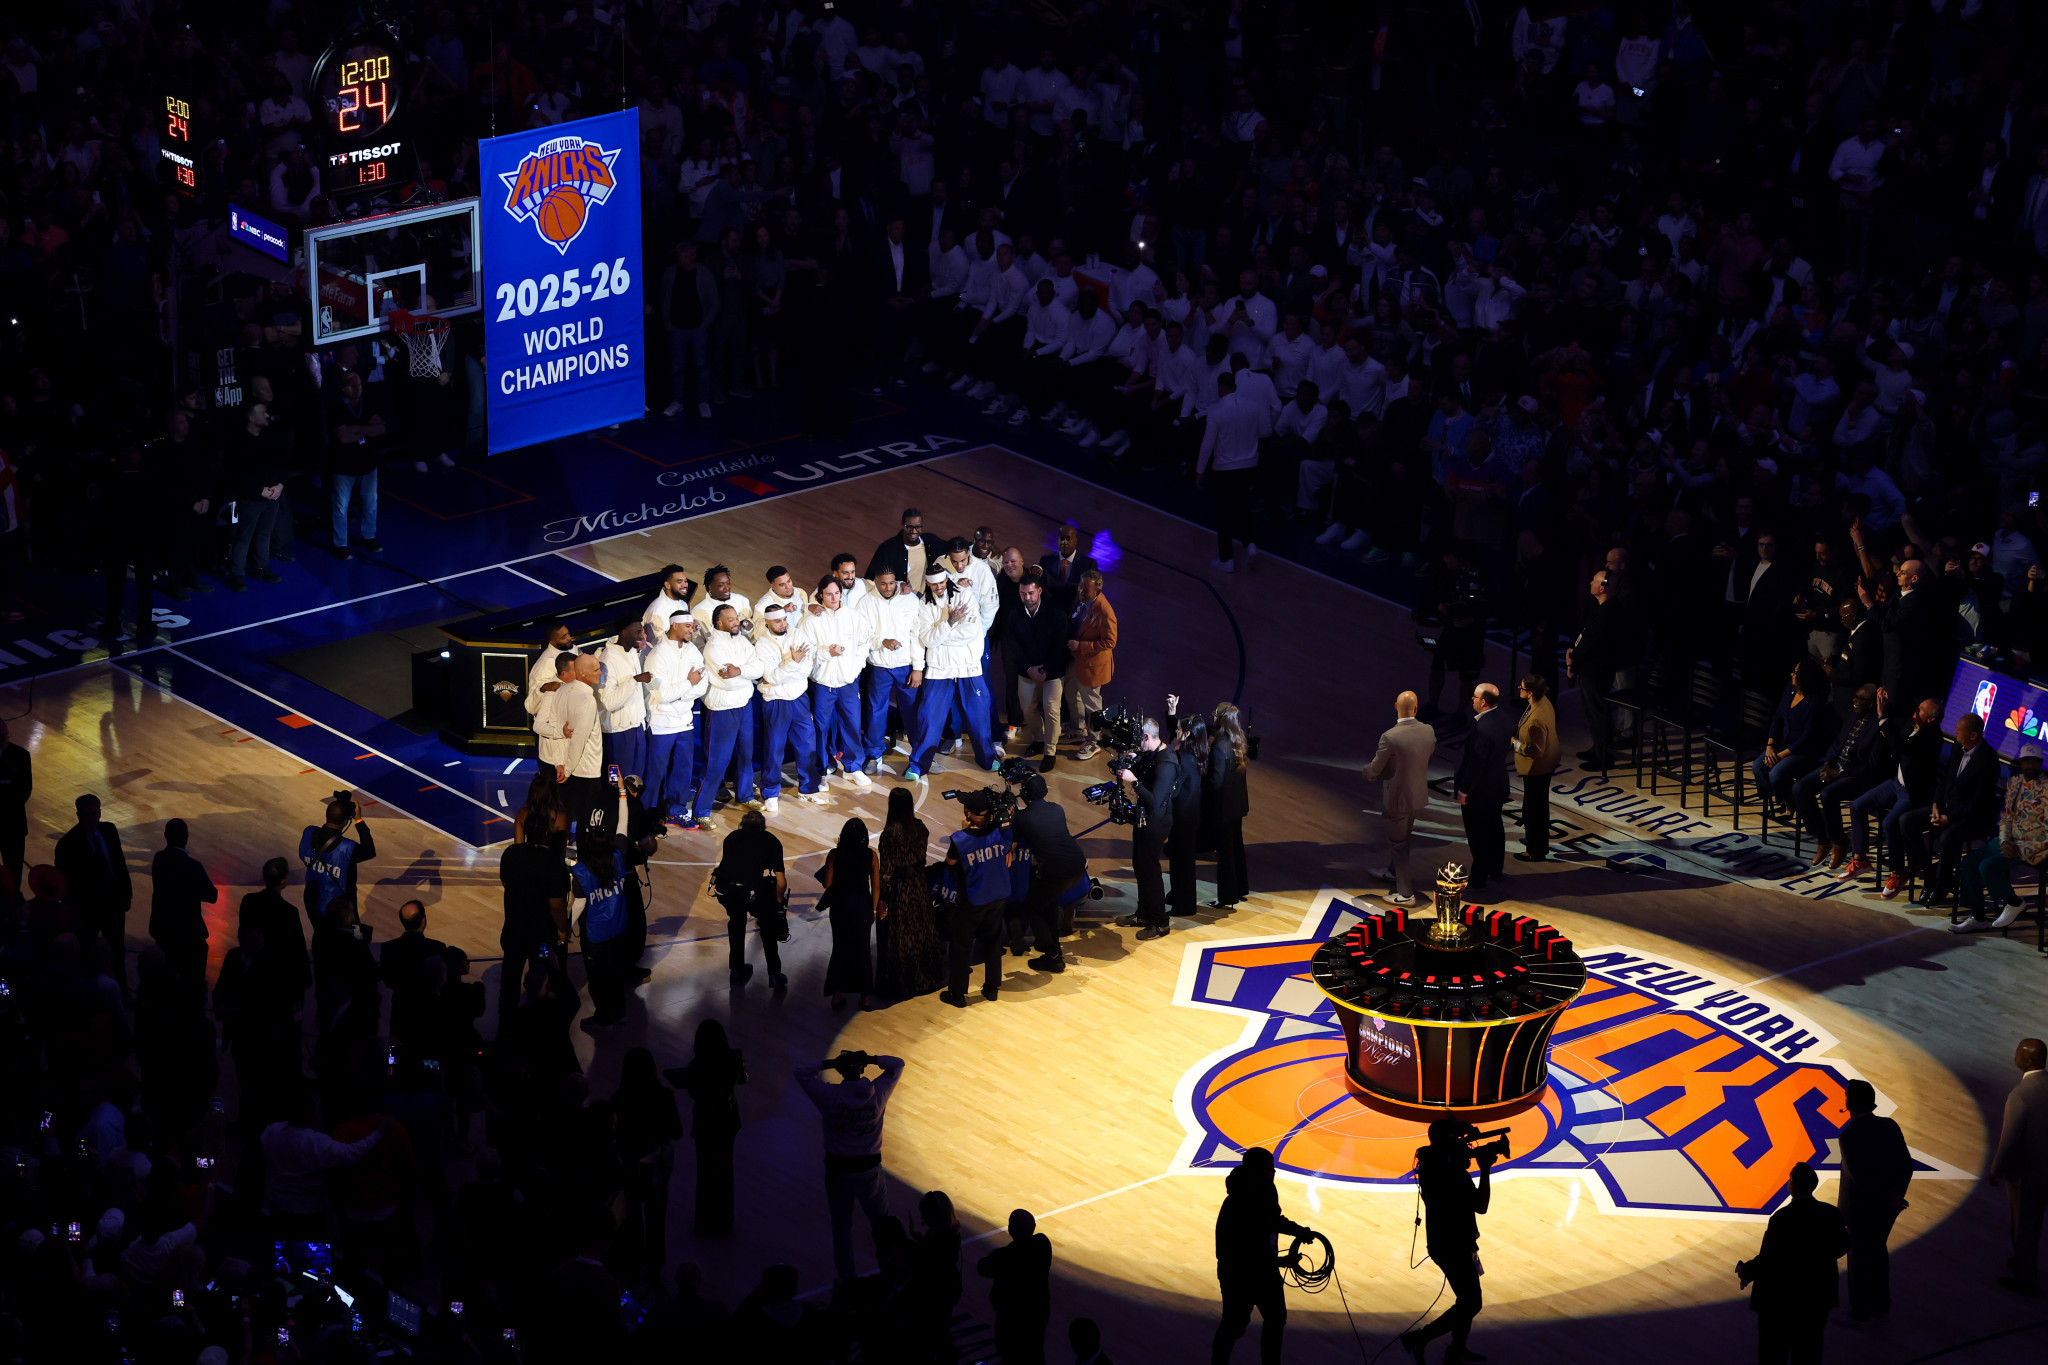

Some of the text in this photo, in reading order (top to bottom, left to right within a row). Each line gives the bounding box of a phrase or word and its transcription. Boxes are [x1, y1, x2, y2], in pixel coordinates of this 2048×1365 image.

[341, 56, 390, 86] 12:00
[166, 96, 190, 119] 12:00
[338, 82, 387, 132] 24
[168, 114, 188, 141] 24
[170, 152, 193, 168] TISSOT
[349, 142, 401, 163] TISSOT
[540, 139, 581, 157] NEW YORK
[177, 166, 195, 187] 1:30
[359, 162, 386, 183] 1:30
[509, 145, 613, 209] KNICKS
[320, 283, 355, 308] ateFarm
[496, 257, 631, 322] 2025-26
[523, 316, 604, 356] WORLD
[217, 348, 236, 367] GET
[501, 343, 629, 395] CHAMPIONS
[218, 366, 238, 386] THE
[225, 387, 243, 407] App
[656, 452, 775, 487] Courtside
[542, 434, 968, 543] Michelob ULTRA
[1552, 775, 1859, 901] SQUARE GARDEN
[1581, 951, 1820, 1061] NEW YORK
[1359, 1023, 1411, 1059] CHAMPIONS
[1360, 1040, 1402, 1066] Night
